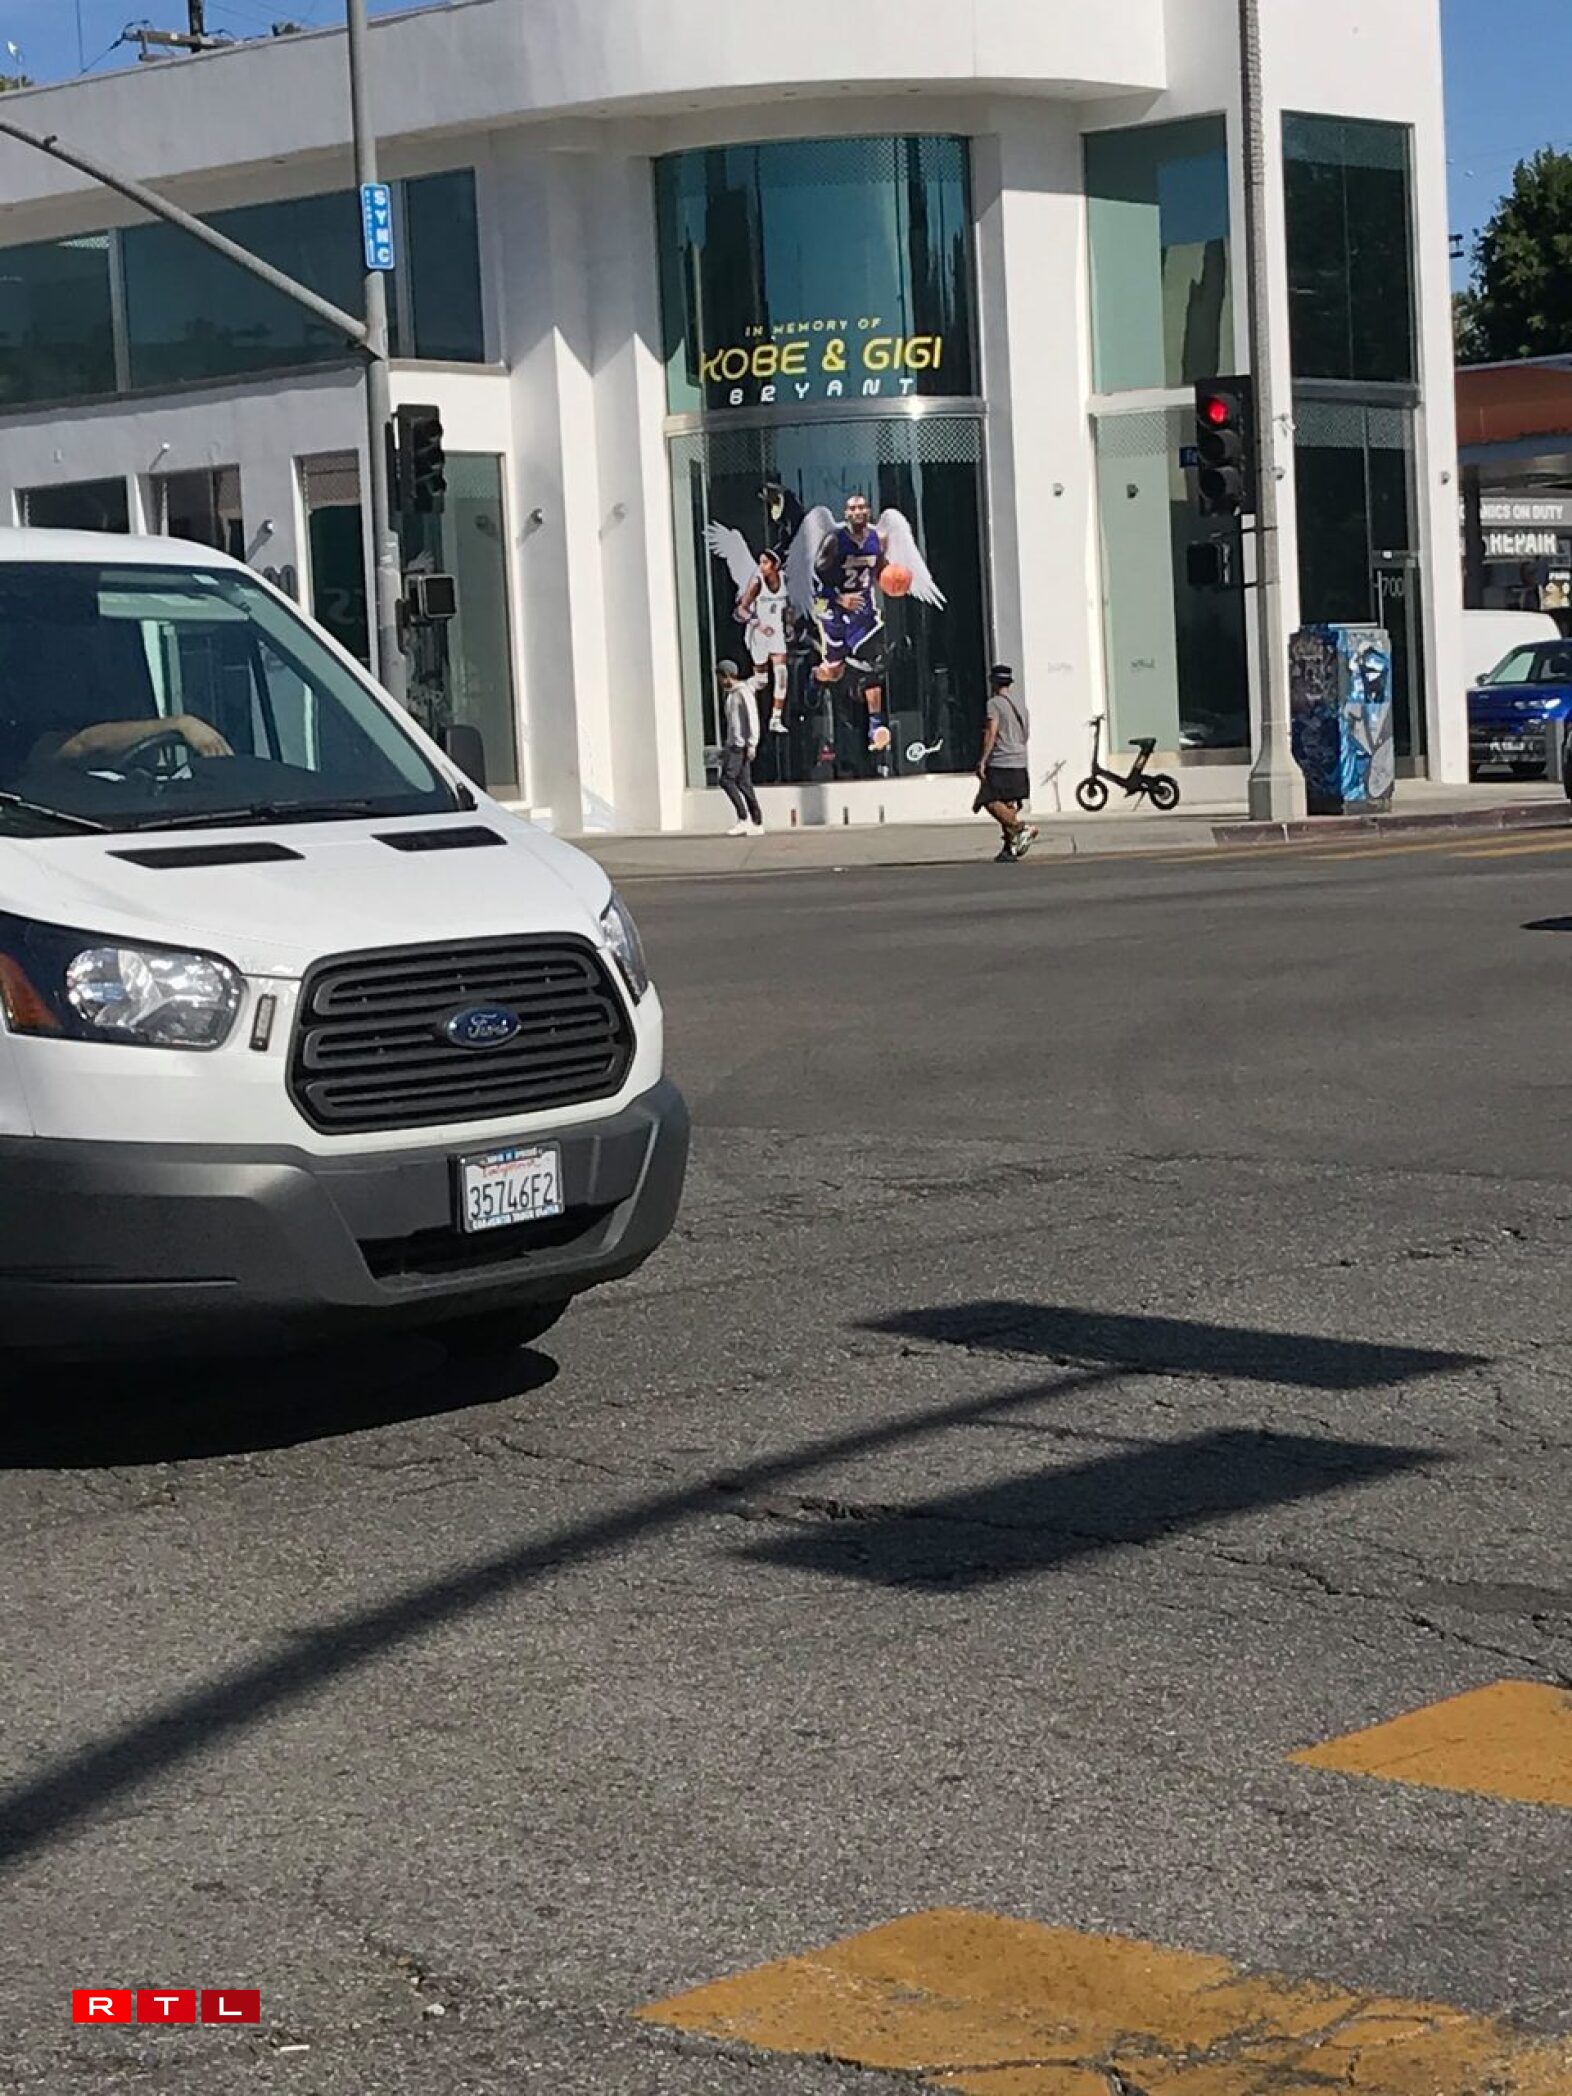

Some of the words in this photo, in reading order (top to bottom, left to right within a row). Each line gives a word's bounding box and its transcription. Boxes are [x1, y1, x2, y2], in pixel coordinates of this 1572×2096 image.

[744, 325, 764, 337] IN
[773, 319, 848, 336] MEMORY
[857, 317, 882, 330] OF
[700, 340, 810, 382] KOBE
[821, 338, 846, 371] &
[862, 336, 943, 371] GIGI
[728, 377, 917, 406] BRYANT
[467, 1013, 509, 1039] Ford
[469, 1171, 553, 1221] 35746F2
